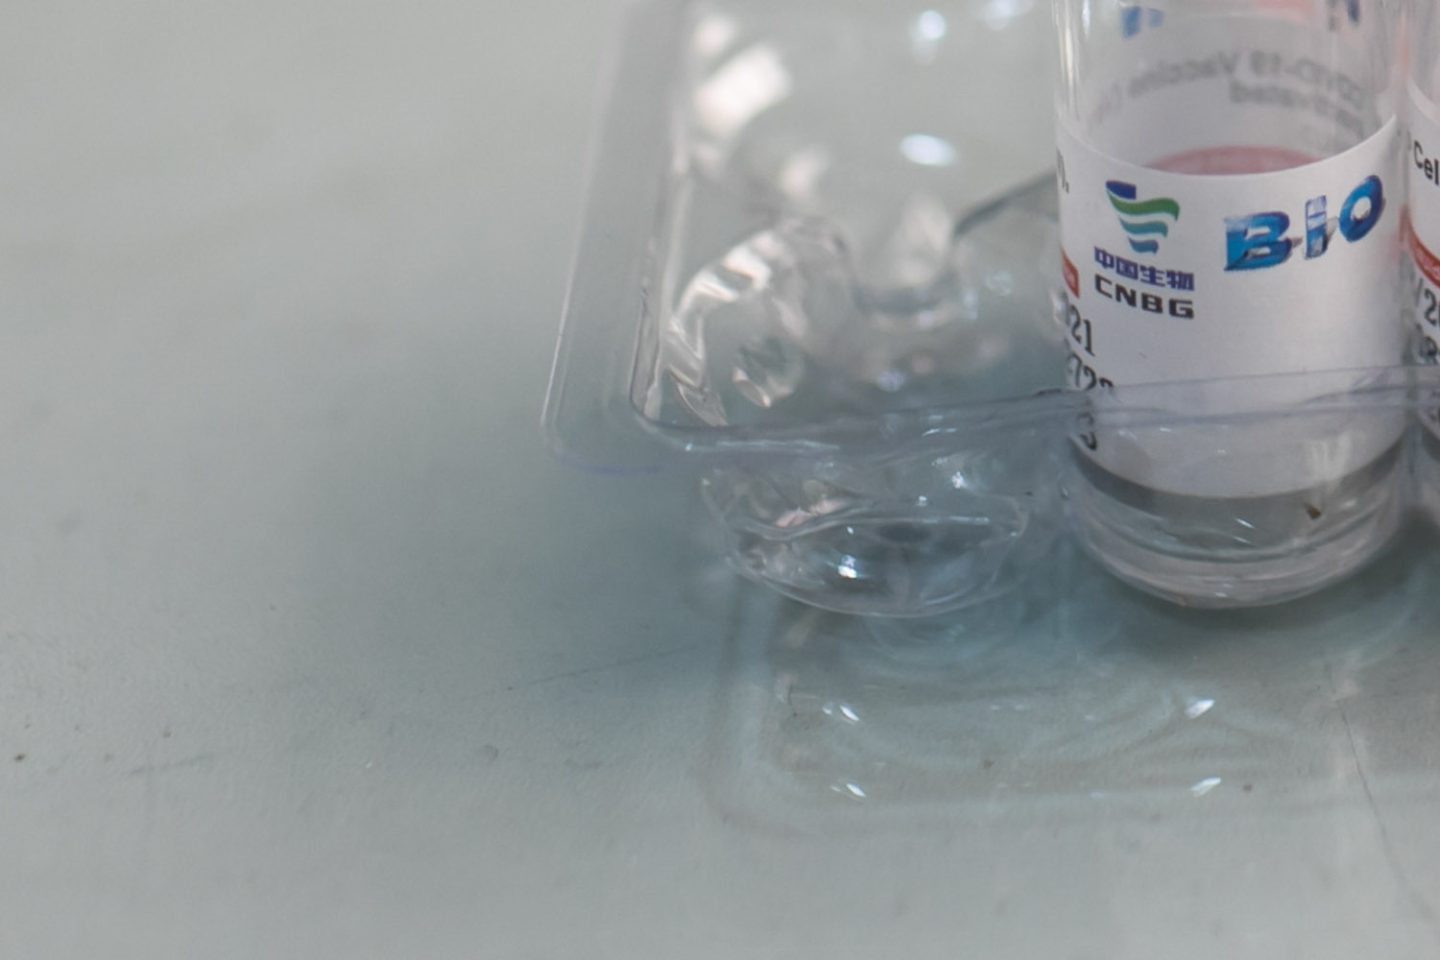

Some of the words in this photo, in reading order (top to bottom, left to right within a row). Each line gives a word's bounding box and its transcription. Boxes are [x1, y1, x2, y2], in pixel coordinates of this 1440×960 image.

[1094, 246, 1195, 292] 中国生物
[1095, 273, 1195, 320] CNBG
